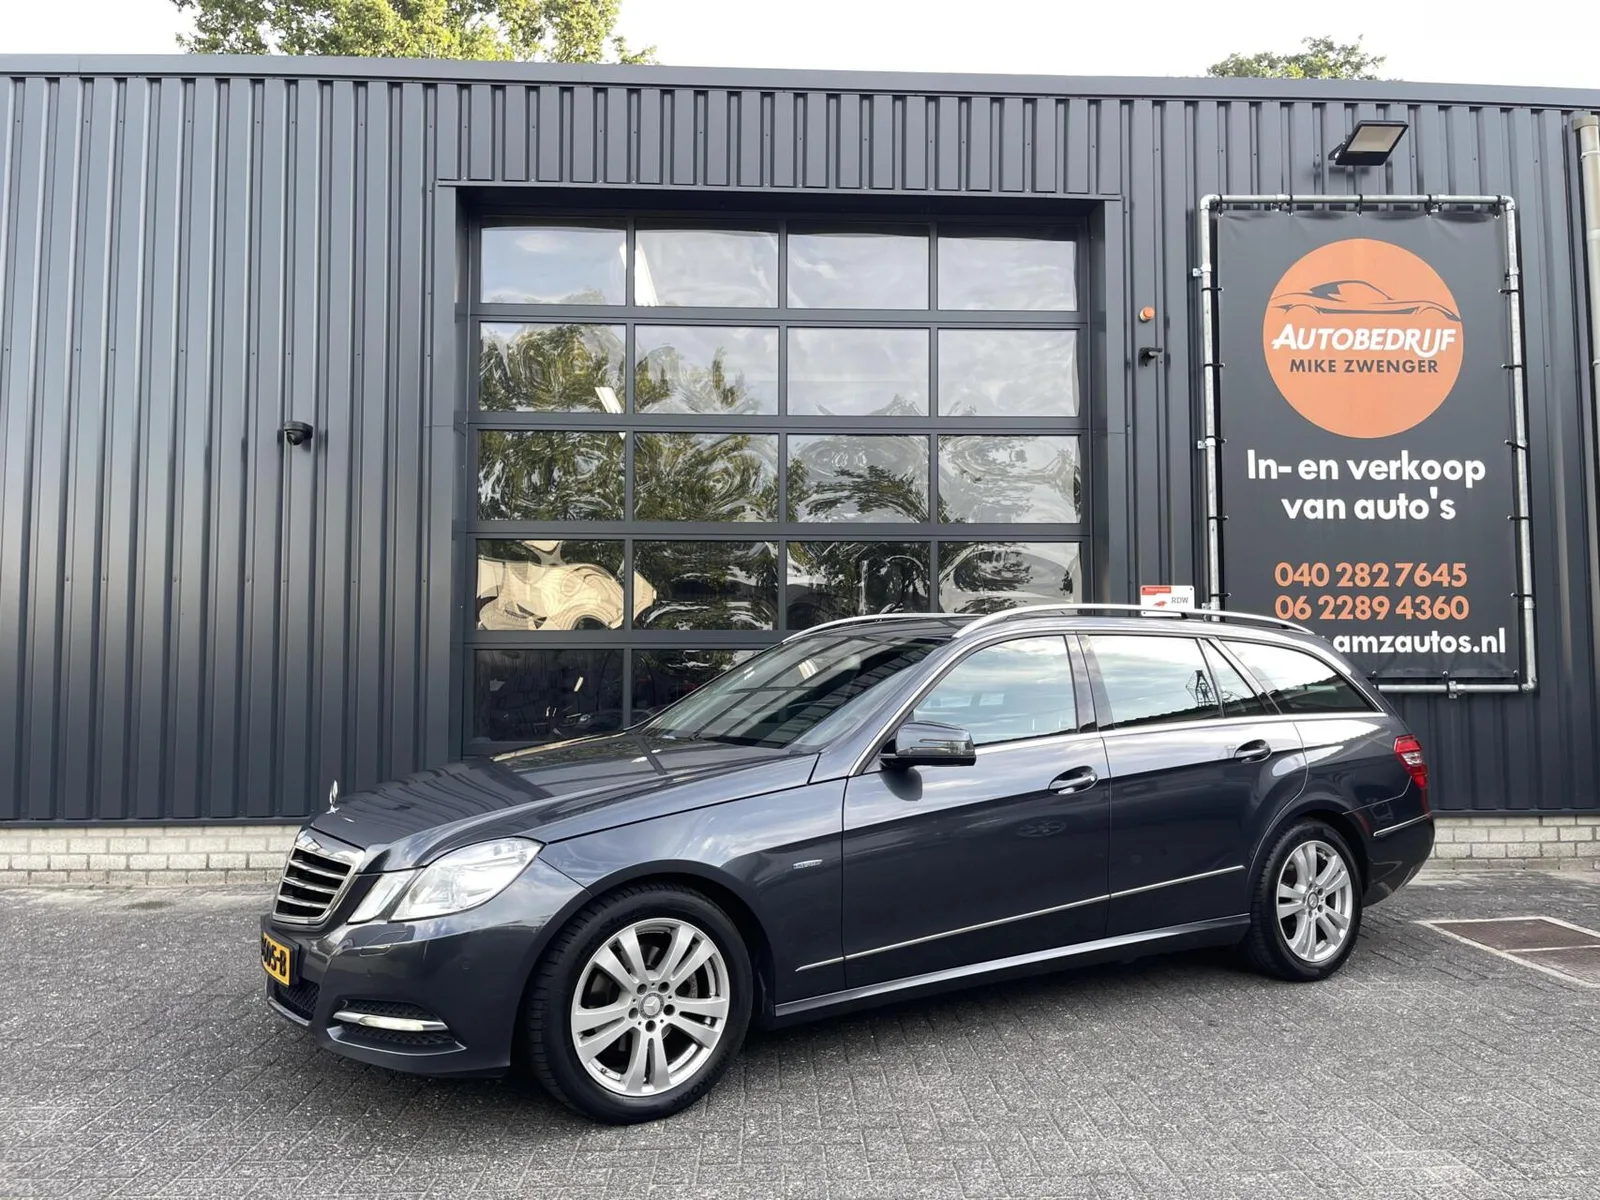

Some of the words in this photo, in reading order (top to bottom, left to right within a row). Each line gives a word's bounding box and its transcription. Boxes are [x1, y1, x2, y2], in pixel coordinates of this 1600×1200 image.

[1271, 323, 1457, 359] AUTOBEDRIJF
[1290, 359, 1336, 373] MIKE
[1344, 359, 1439, 373] ZWENGER
[1247, 450, 1293, 480] In-
[1298, 459, 1339, 480] en
[1347, 450, 1486, 489] verkoop
[1280, 498, 1346, 520] van
[1354, 486, 1457, 520] auto's
[1274, 561, 1330, 588] 040
[1336, 561, 1389, 588] 282
[1395, 561, 1468, 588] 7645
[1274, 594, 1312, 620] 06
[1318, 594, 1390, 620] 2289
[1395, 594, 1470, 620] 4360
[1322, 627, 1506, 654] amzautos.nl
